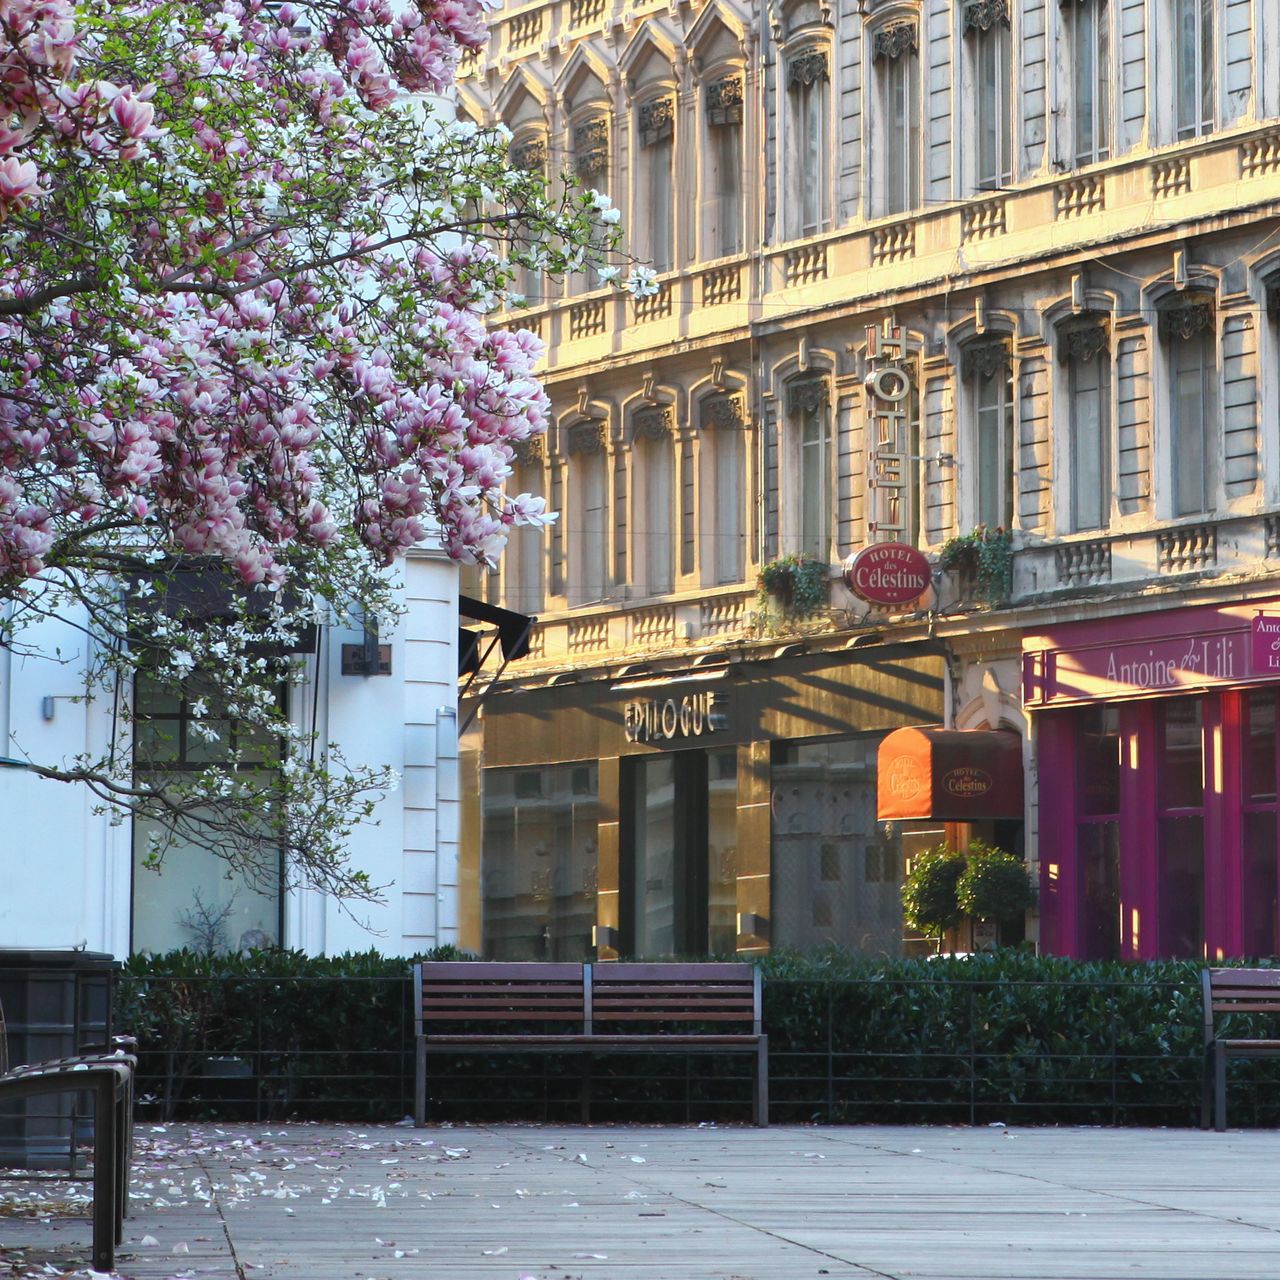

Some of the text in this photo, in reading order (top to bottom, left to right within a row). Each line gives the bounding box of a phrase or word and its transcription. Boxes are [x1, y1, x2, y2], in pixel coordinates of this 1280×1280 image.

[869, 549, 912, 563] HOTEL
[884, 561, 897, 570] des
[856, 567, 925, 589] Célestins
[1106, 650, 1176, 688] Antoine
[1202, 637, 1234, 680] Lili
[624, 691, 726, 742] EPILOGUE
